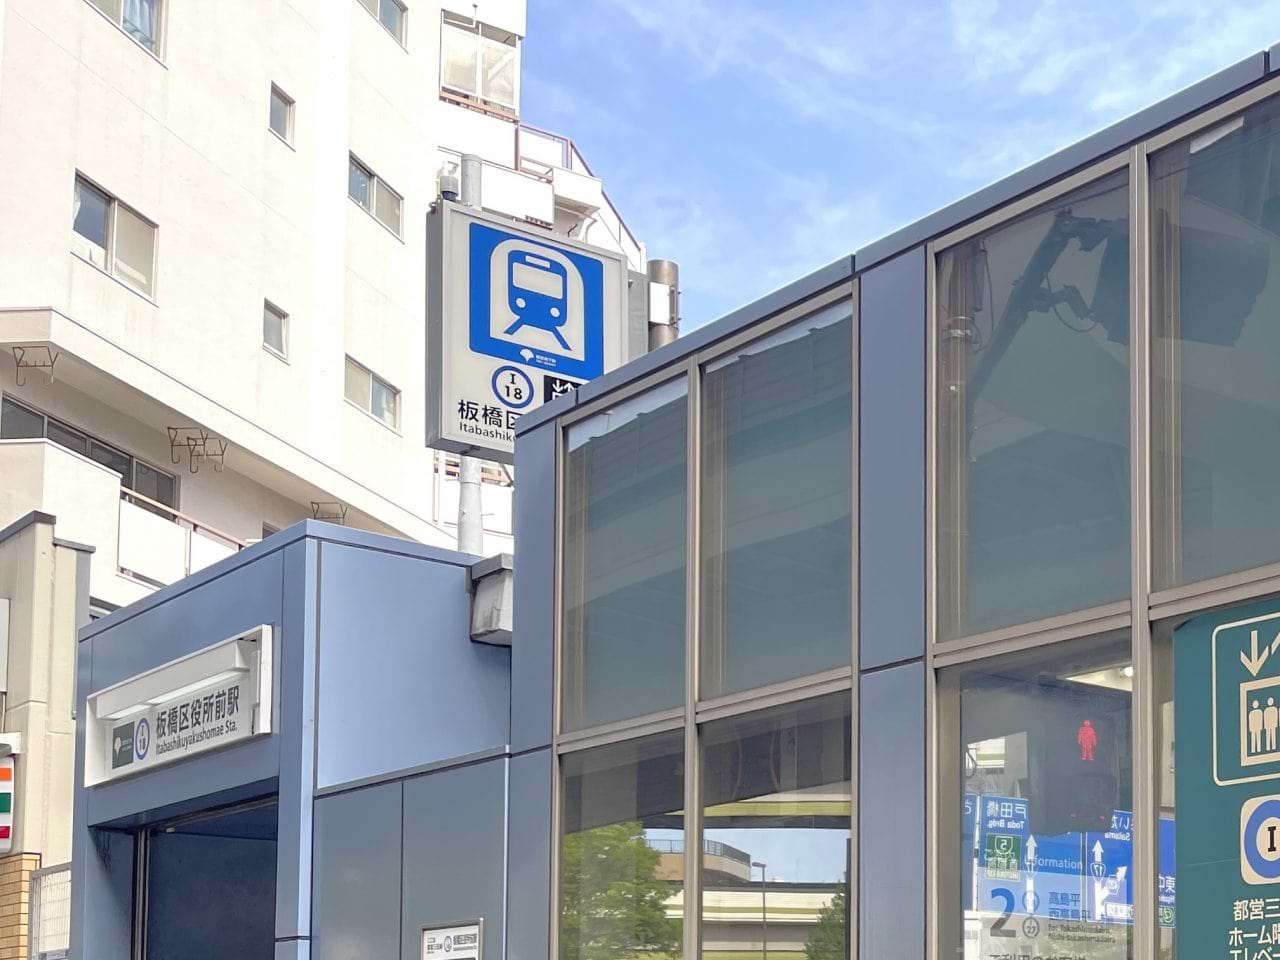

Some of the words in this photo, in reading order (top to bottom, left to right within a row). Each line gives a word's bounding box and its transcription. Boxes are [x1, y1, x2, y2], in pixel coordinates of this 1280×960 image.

[505, 385, 522, 399] 18
[510, 373, 516, 385] I
[156, 685, 240, 740] 板橋区役所前駅
[1267, 826, 1277, 852] I
[989, 887, 1017, 938] 2
